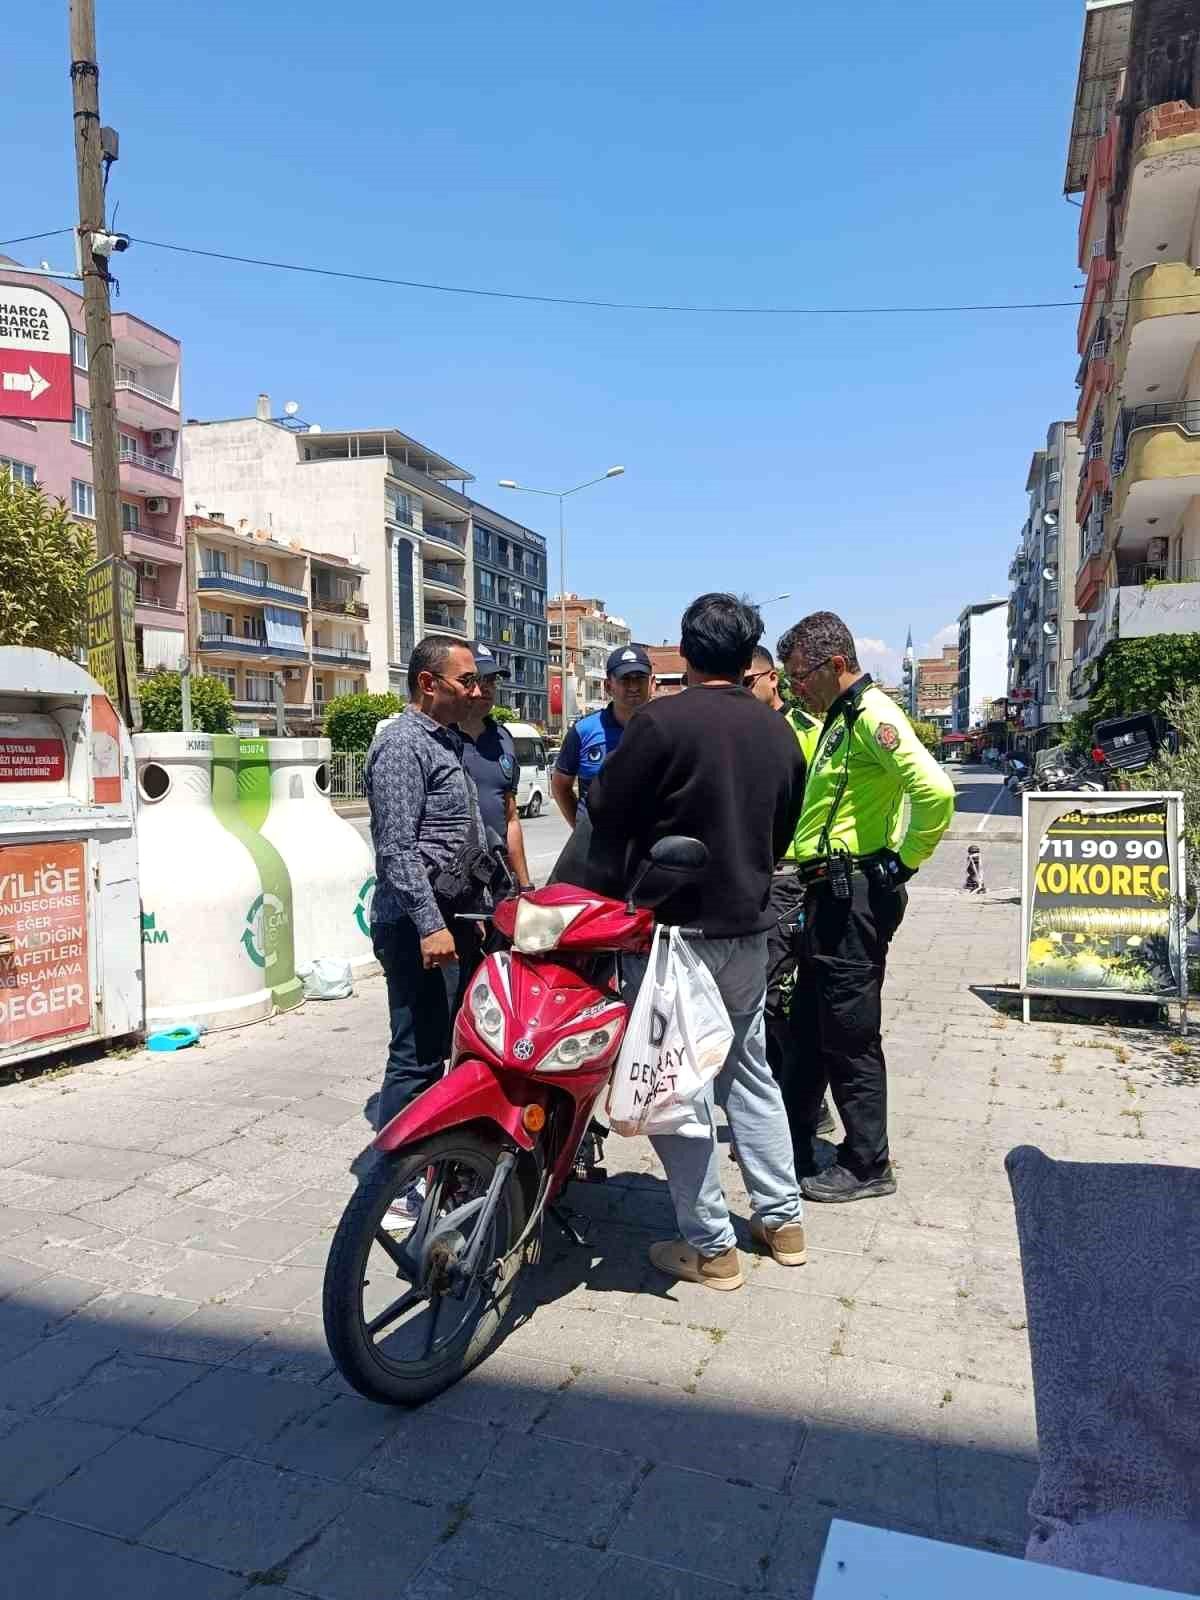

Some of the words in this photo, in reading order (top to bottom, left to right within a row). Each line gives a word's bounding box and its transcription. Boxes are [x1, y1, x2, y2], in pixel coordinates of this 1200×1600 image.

[0, 304, 48, 318] HARCA
[0, 315, 49, 330] HARCA
[1081, 839, 1118, 859] 90
[1125, 840, 1163, 860] 90
